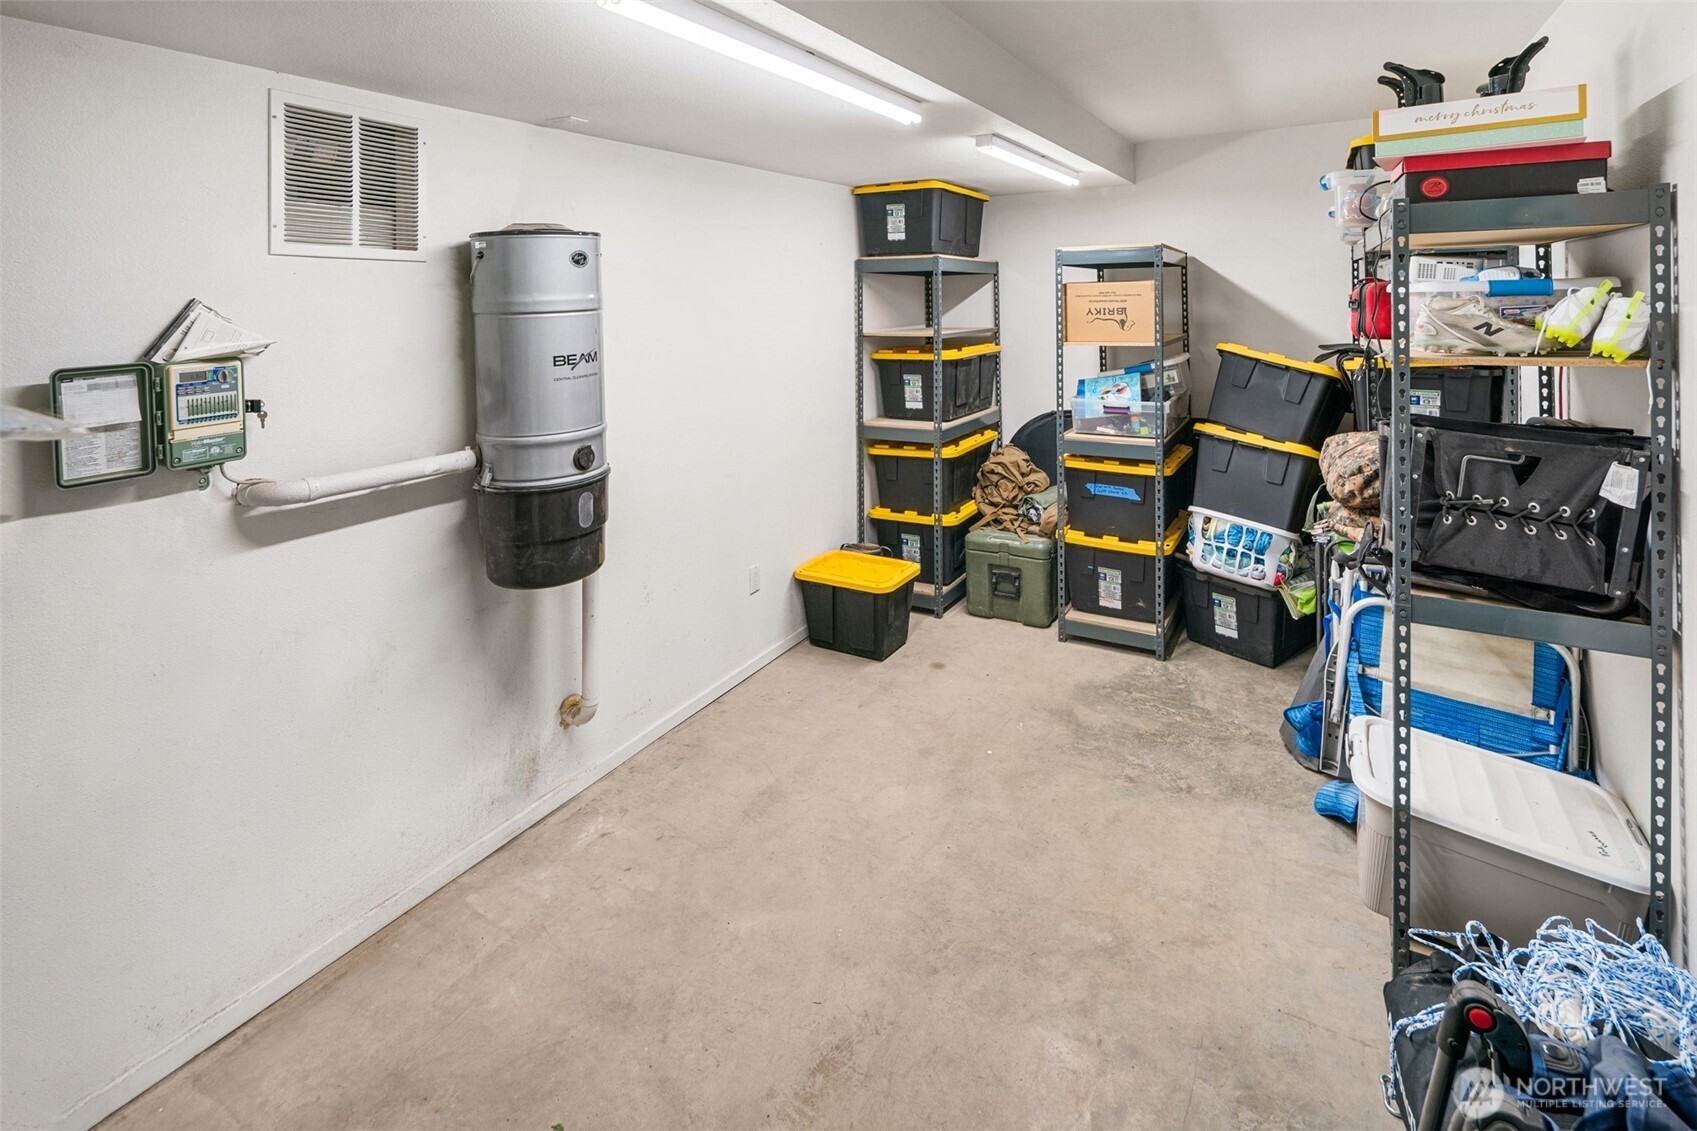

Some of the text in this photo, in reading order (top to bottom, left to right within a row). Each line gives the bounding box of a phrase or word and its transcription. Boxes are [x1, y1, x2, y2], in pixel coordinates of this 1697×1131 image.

[1414, 99, 1536, 124] merry christmas
[1086, 307, 1127, 316] BRIKY
[553, 350, 598, 368] BEAM
